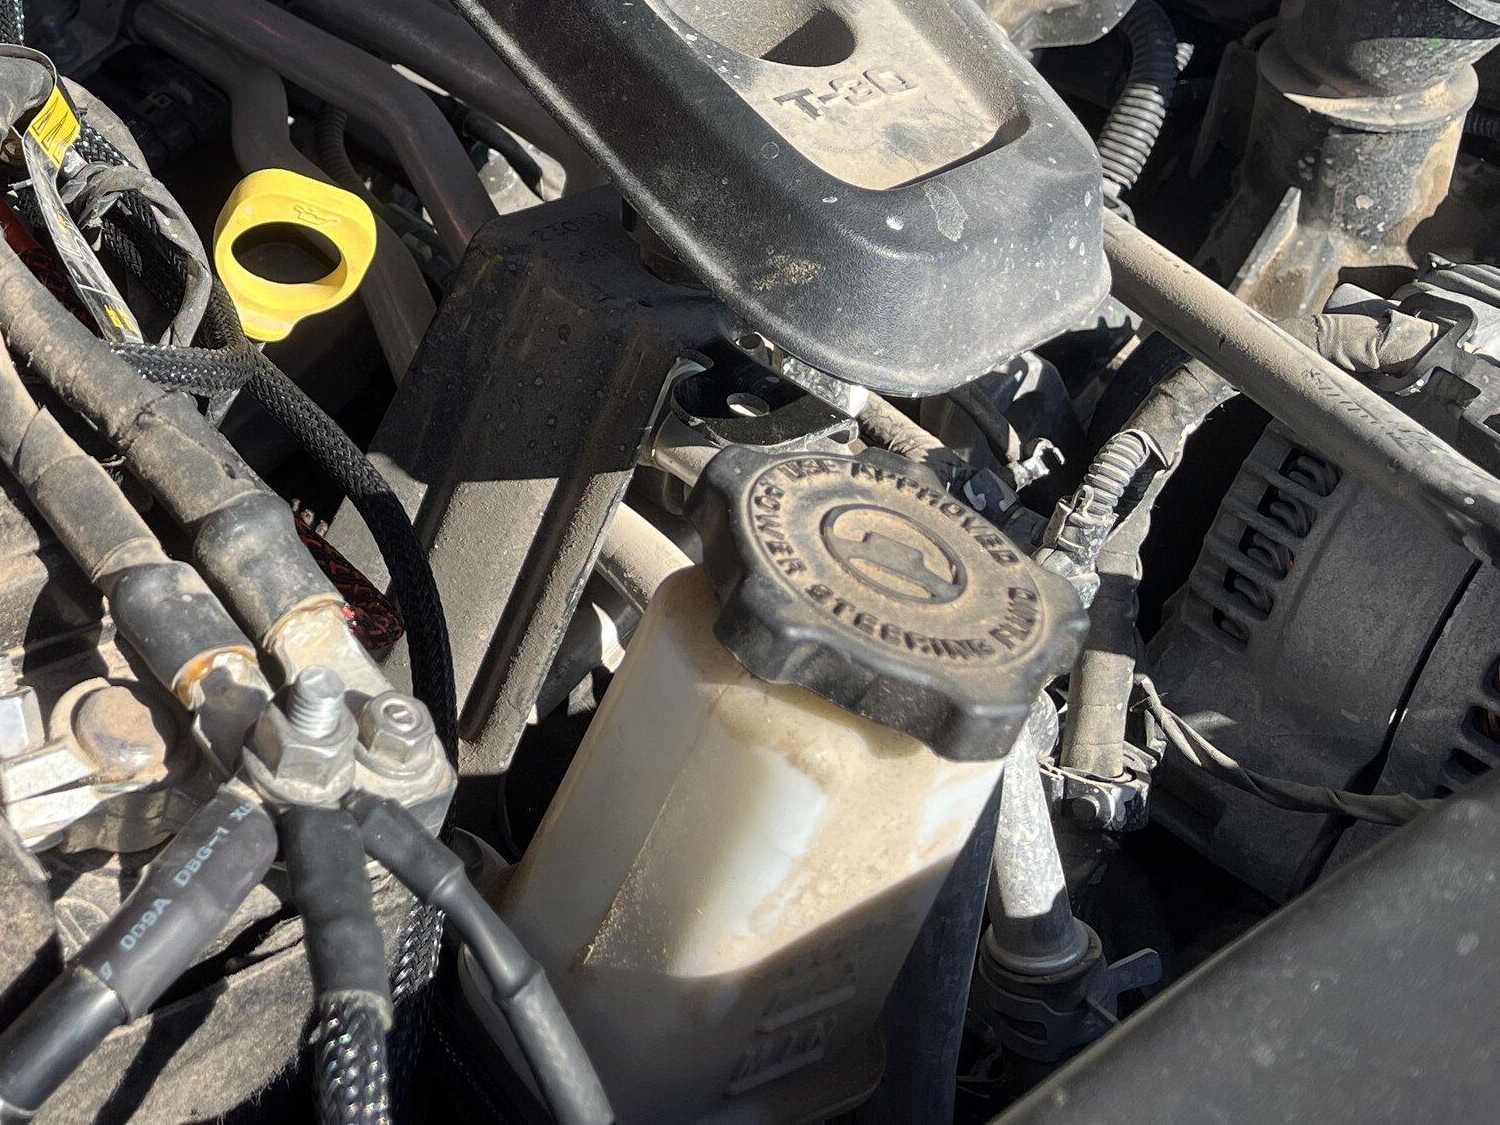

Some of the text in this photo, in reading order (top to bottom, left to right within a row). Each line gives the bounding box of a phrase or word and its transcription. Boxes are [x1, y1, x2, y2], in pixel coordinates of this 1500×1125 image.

[753, 478, 1038, 660] POWER STEERING FLUID
[850, 461, 1021, 567] APPROVED
